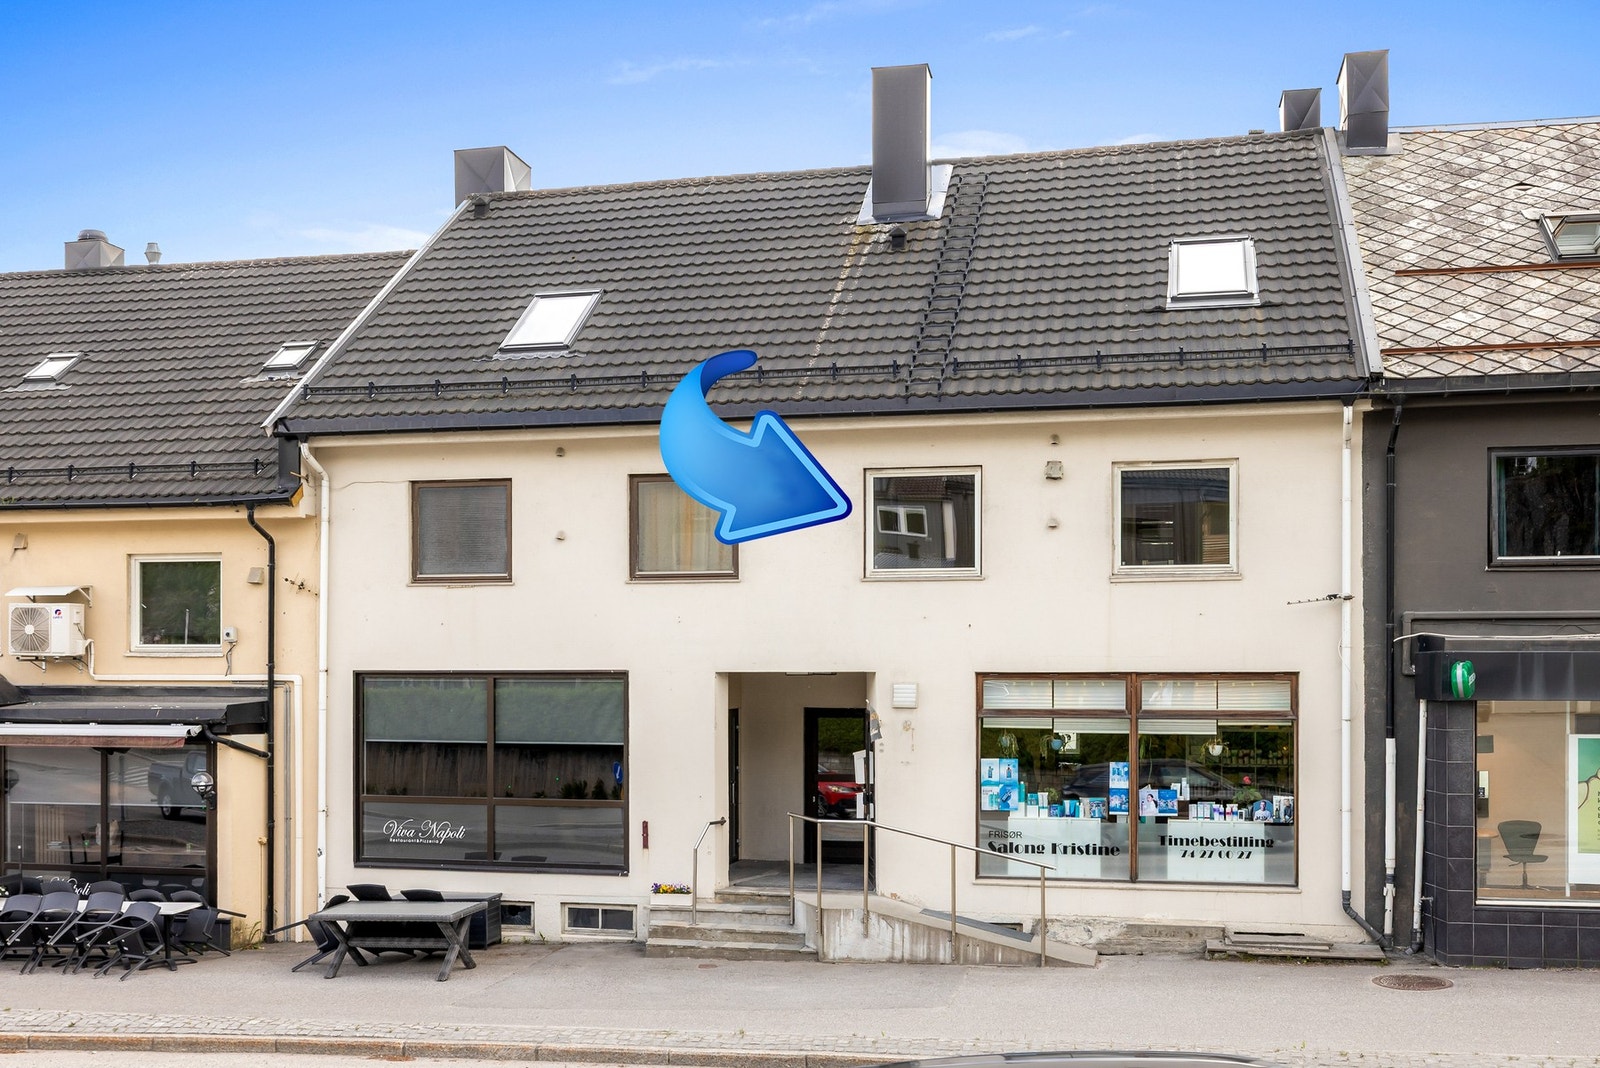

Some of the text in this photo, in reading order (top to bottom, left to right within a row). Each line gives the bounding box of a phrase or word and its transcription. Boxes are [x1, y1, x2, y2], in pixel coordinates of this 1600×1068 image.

[383, 819, 466, 845] Viva Napoli
[988, 830, 1023, 839] FRISØR
[1158, 835, 1275, 848] Timebestilling
[987, 841, 1121, 856] Salong Kristine
[1180, 849, 1253, 859] 74 27 00 27
